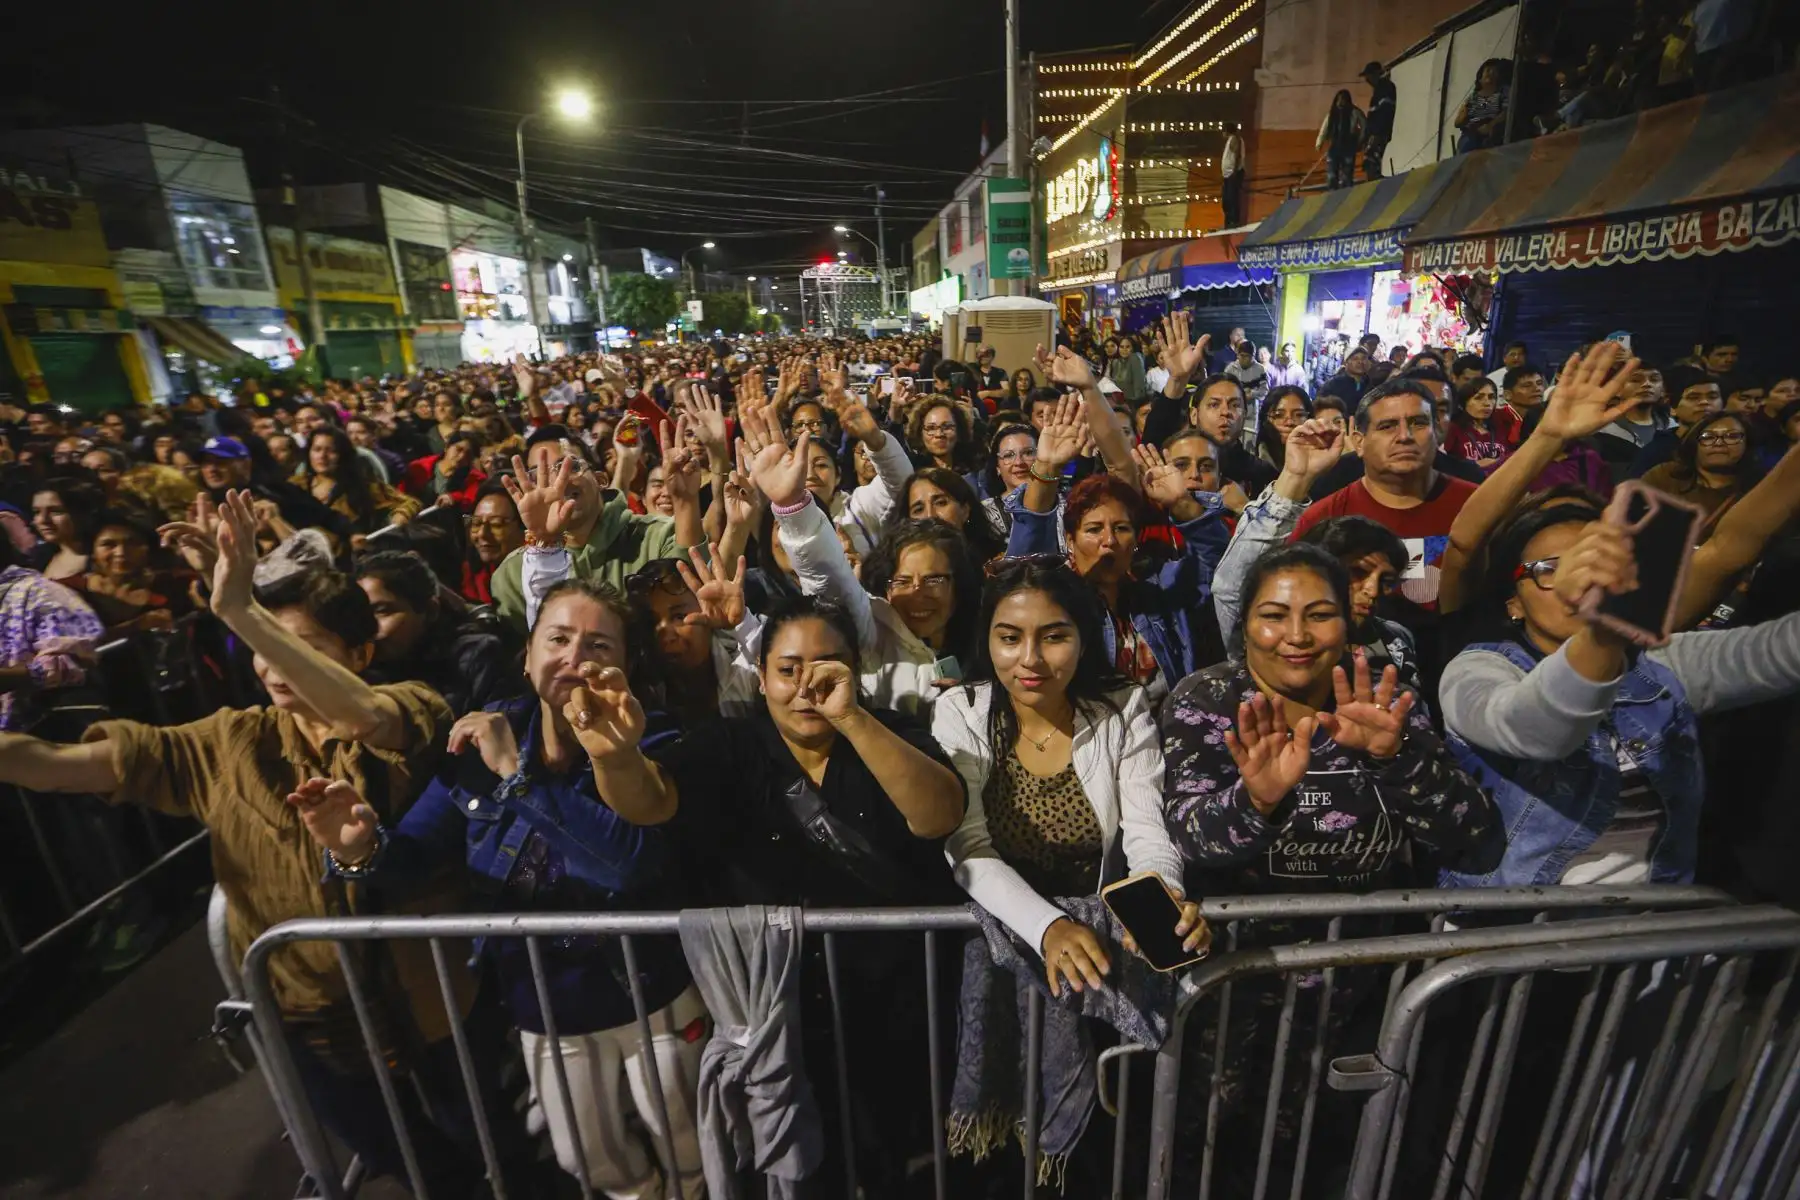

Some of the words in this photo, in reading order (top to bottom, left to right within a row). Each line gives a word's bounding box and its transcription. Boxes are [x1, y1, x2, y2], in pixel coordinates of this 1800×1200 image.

[1494, 231, 1567, 263] VALERA
[1312, 816, 1327, 832] is
[1285, 858, 1318, 872] with
